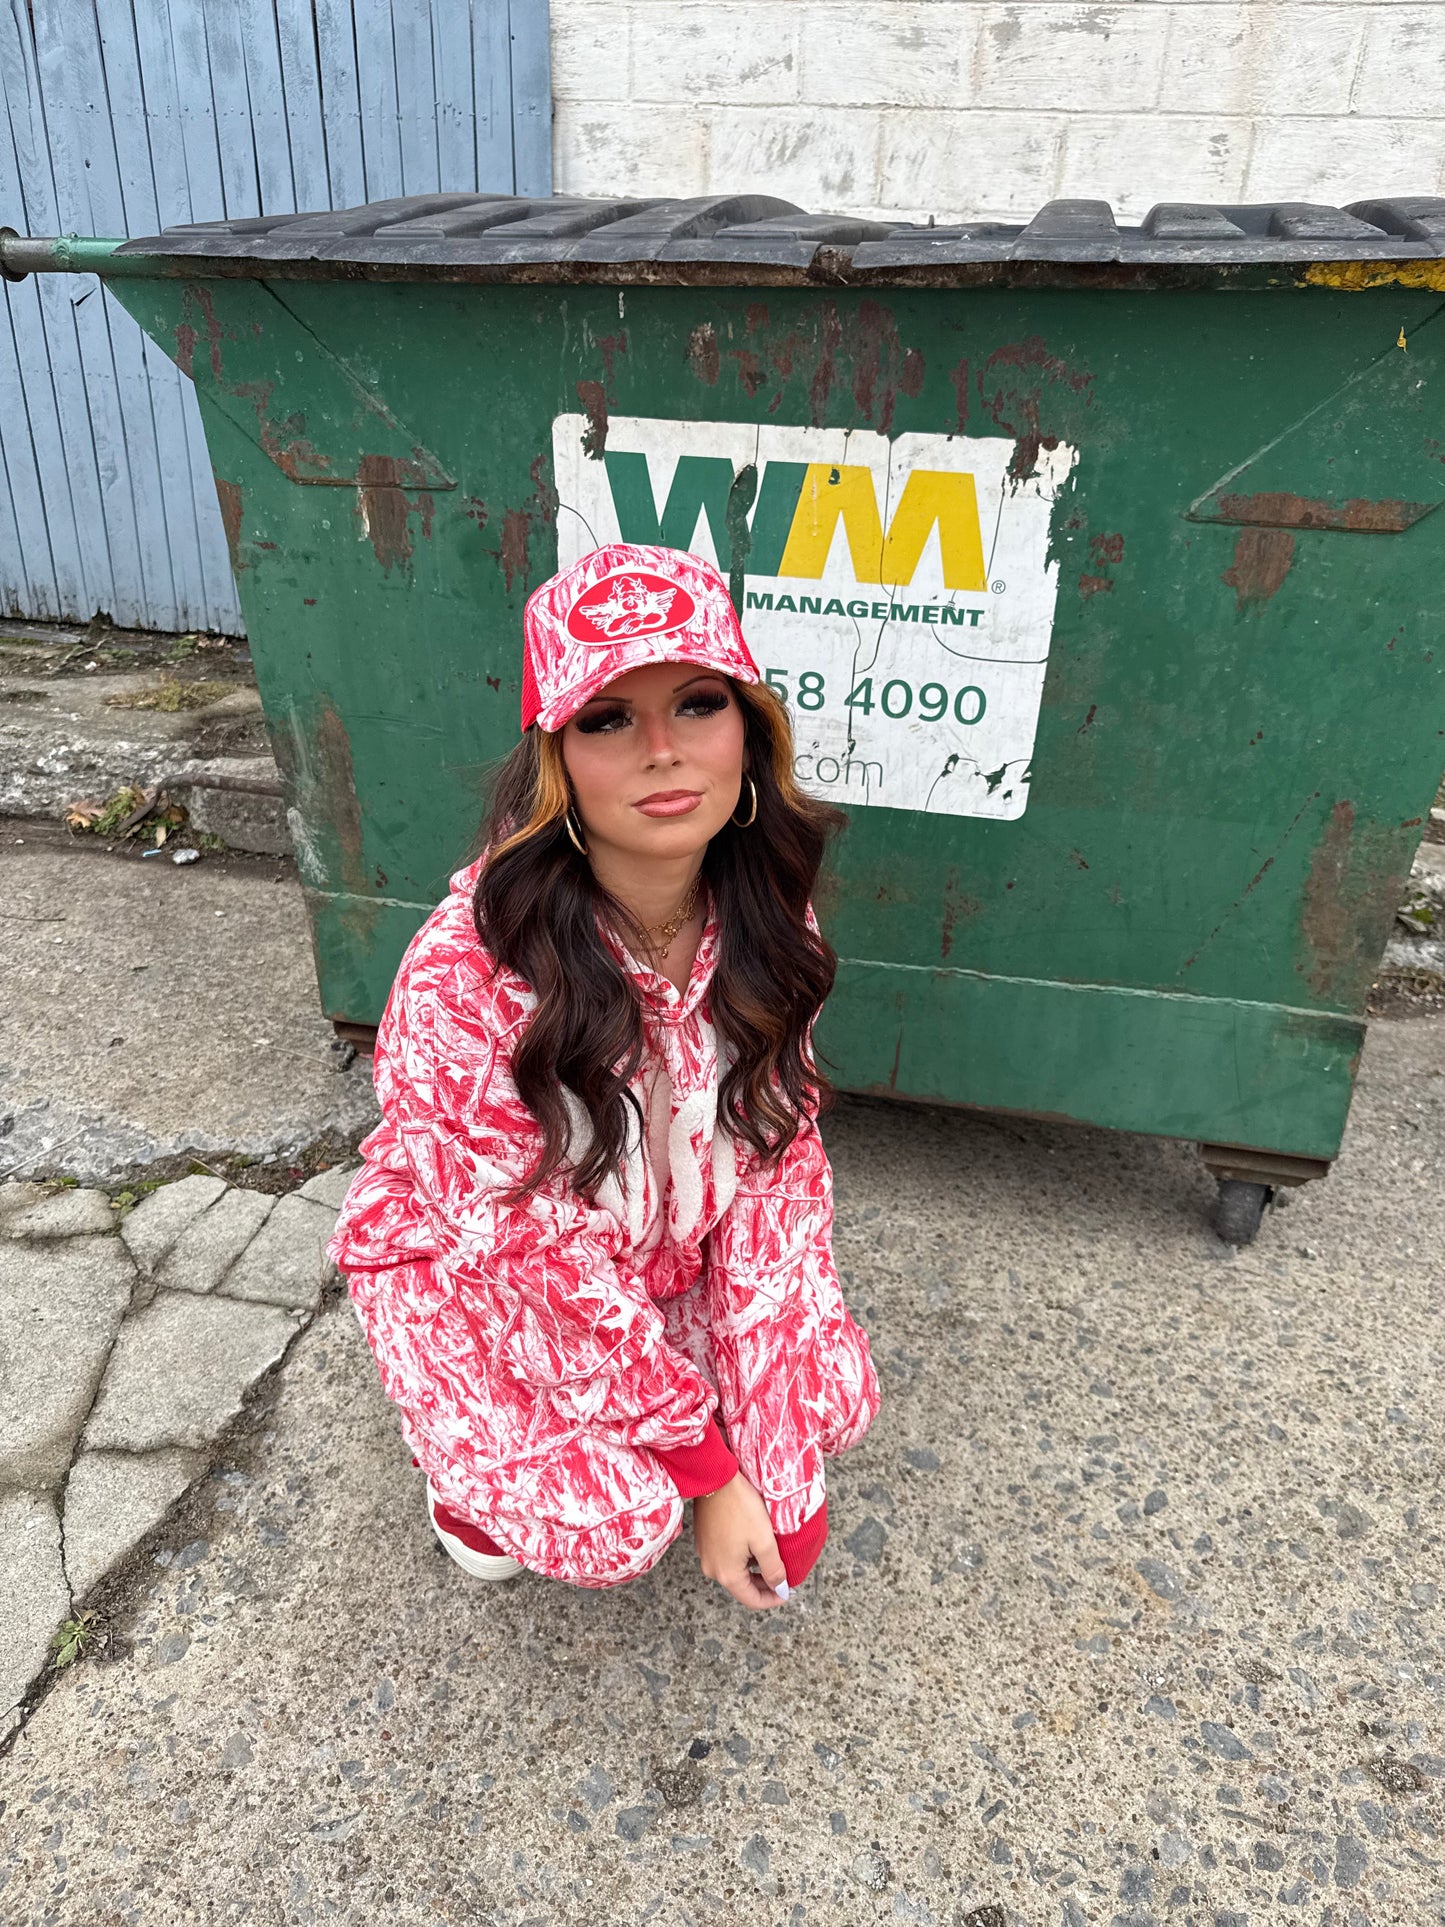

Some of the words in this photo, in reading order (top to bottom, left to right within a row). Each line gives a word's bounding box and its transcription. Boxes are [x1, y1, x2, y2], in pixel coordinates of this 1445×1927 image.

[604, 450, 988, 592] WM
[746, 591, 985, 627] MANAGEMENT
[844, 677, 987, 725] 4090
